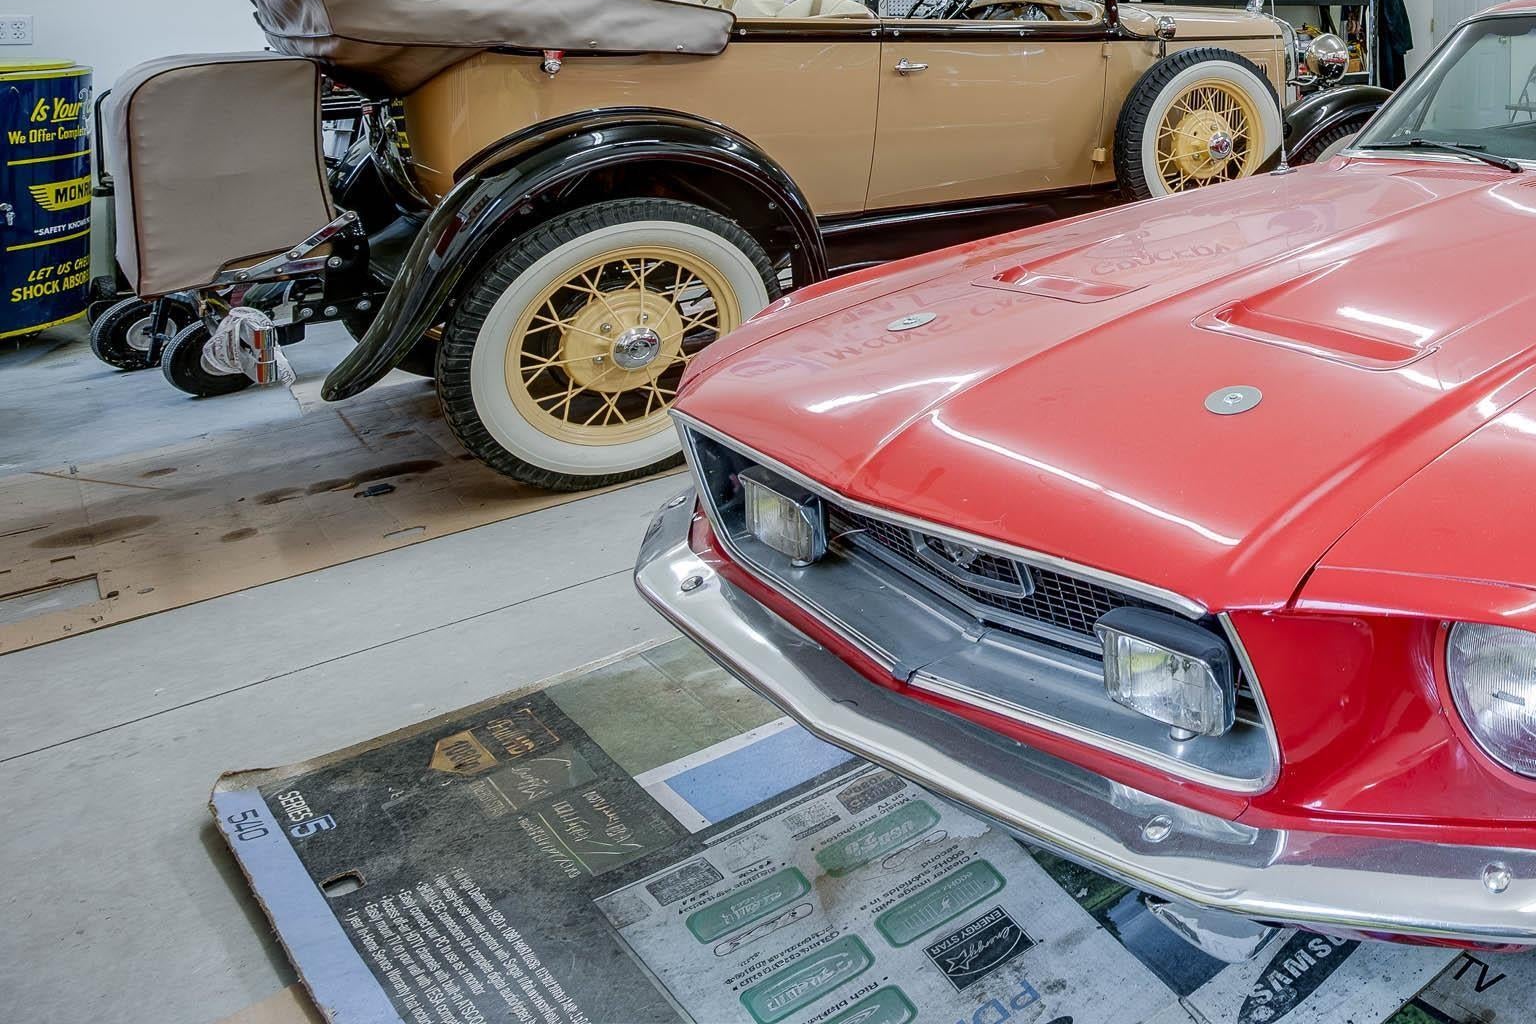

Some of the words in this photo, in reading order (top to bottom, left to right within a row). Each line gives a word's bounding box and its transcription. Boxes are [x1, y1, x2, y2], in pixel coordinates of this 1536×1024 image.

[30, 98, 50, 122] Is
[52, 97, 81, 120] Your
[8, 131, 26, 145] We
[29, 128, 56, 144] Offer
[27, 266, 54, 282] LET
[57, 261, 72, 275] US
[10, 279, 60, 303] SHOCK
[278, 790, 314, 822] SERIES
[877, 798, 892, 810] TV
[879, 797, 911, 816] Music
[893, 792, 905, 802] on
[227, 809, 269, 842] 540
[290, 814, 337, 838] 5
[857, 817, 877, 831] and
[820, 824, 858, 847] photos
[921, 845, 959, 869] second
[933, 855, 970, 880] Clearer
[934, 850, 966, 870] 600Hz
[883, 866, 933, 899] subfields
[897, 874, 932, 898] image
[378, 896, 404, 918] Access
[394, 889, 420, 909] Easily
[466, 886, 496, 913] Definition
[485, 908, 507, 925] 1920
[869, 894, 882, 907] in
[871, 893, 896, 914] with
[345, 915, 365, 930] year
[359, 902, 386, 923] Easily
[408, 905, 433, 928] connect
[373, 919, 396, 938] mount
[419, 925, 440, 940] your
[964, 909, 1003, 938] ENERGY
[355, 926, 383, 951] In-Home
[386, 934, 403, 946] TV
[403, 930, 426, 948] HDTV
[431, 935, 450, 947] PC
[929, 929, 964, 955] STAR
[370, 948, 397, 971] Service
[393, 951, 414, 967] your
[414, 944, 444, 971] channels
[443, 951, 460, 963] use
[406, 962, 425, 976] wall
[431, 967, 453, 983] with
[464, 947, 497, 975] complete
[482, 969, 510, 991] digital
[1453, 951, 1507, 993] TV
[379, 967, 415, 998] Warranty
[413, 972, 434, 988] with
[460, 971, 488, 995] monitor
[850, 981, 879, 1000] Rich
[401, 993, 423, 1009] that
[420, 983, 448, 1006] VESA
